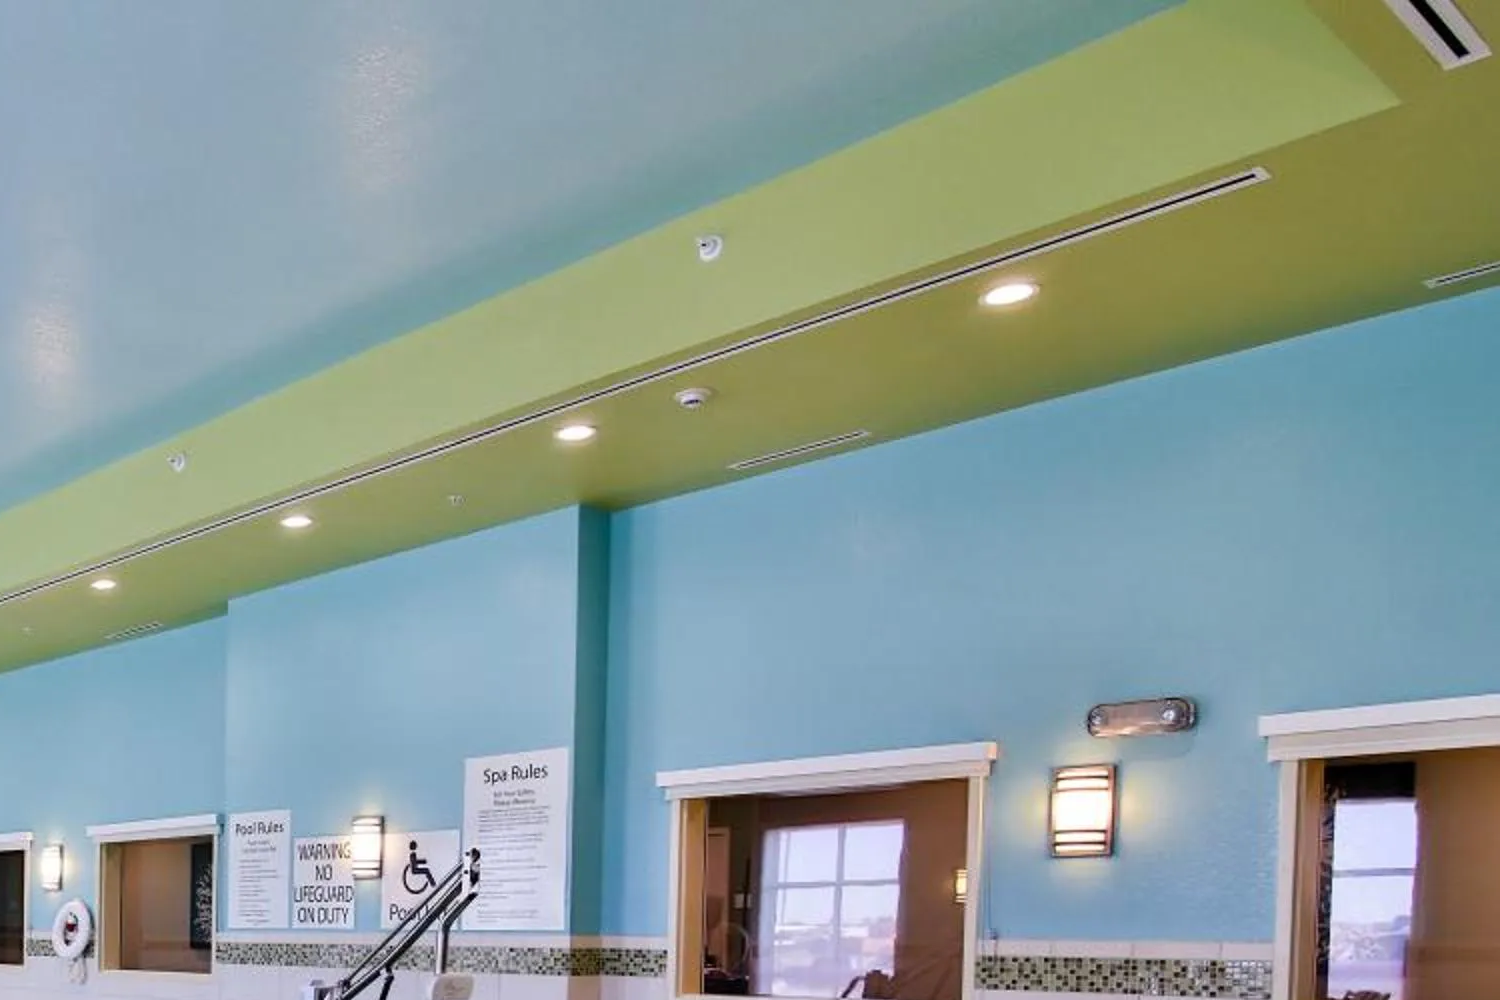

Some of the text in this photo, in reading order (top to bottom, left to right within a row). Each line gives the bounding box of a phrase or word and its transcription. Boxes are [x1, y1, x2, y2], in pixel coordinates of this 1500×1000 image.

[483, 763, 549, 787] Spa Rules
[235, 821, 284, 836] Pool Rules
[297, 841, 352, 861] WARNING
[315, 864, 333, 881] NO
[293, 885, 355, 903] LIFEGUARD
[297, 907, 350, 924] ON DUTY
